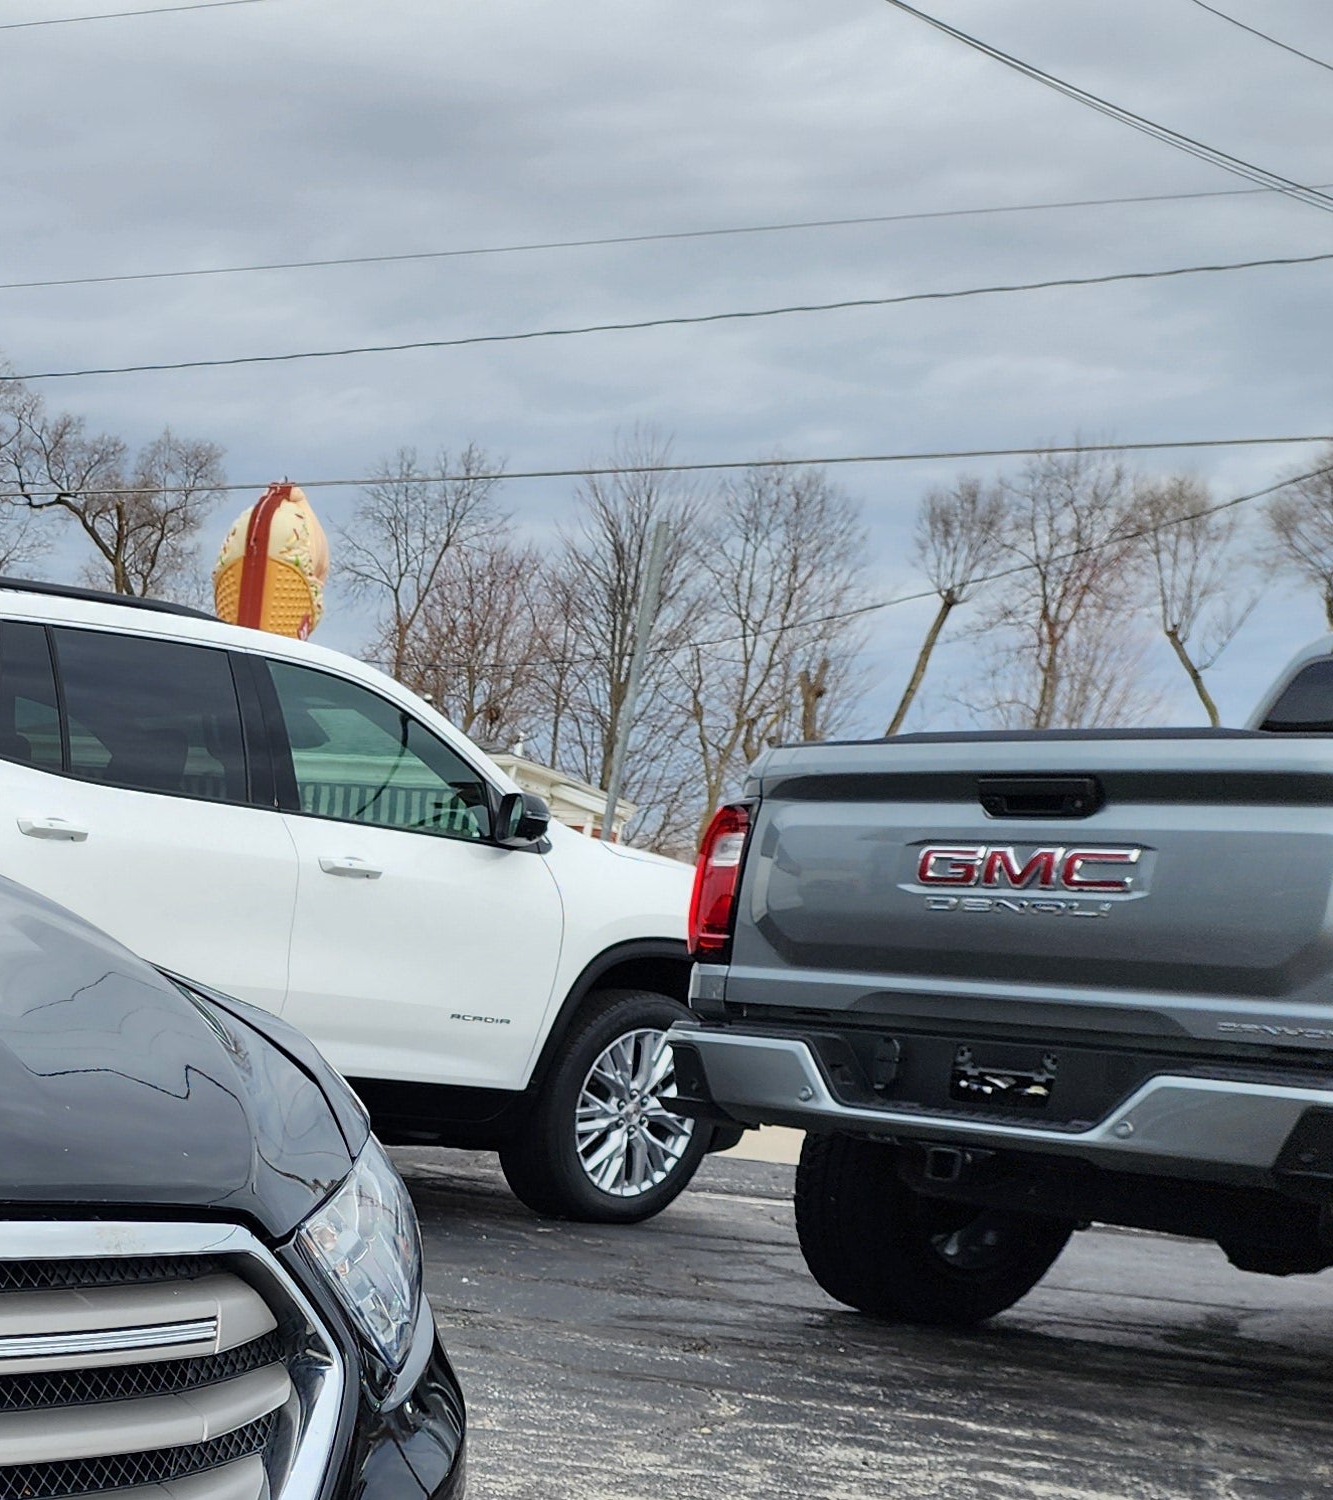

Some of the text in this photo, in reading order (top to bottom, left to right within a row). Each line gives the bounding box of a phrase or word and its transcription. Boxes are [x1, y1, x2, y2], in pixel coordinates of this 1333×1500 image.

[917, 845, 1142, 893] GMC
[925, 896, 1113, 918] DENALI
[450, 1013, 511, 1025] ACADIA
